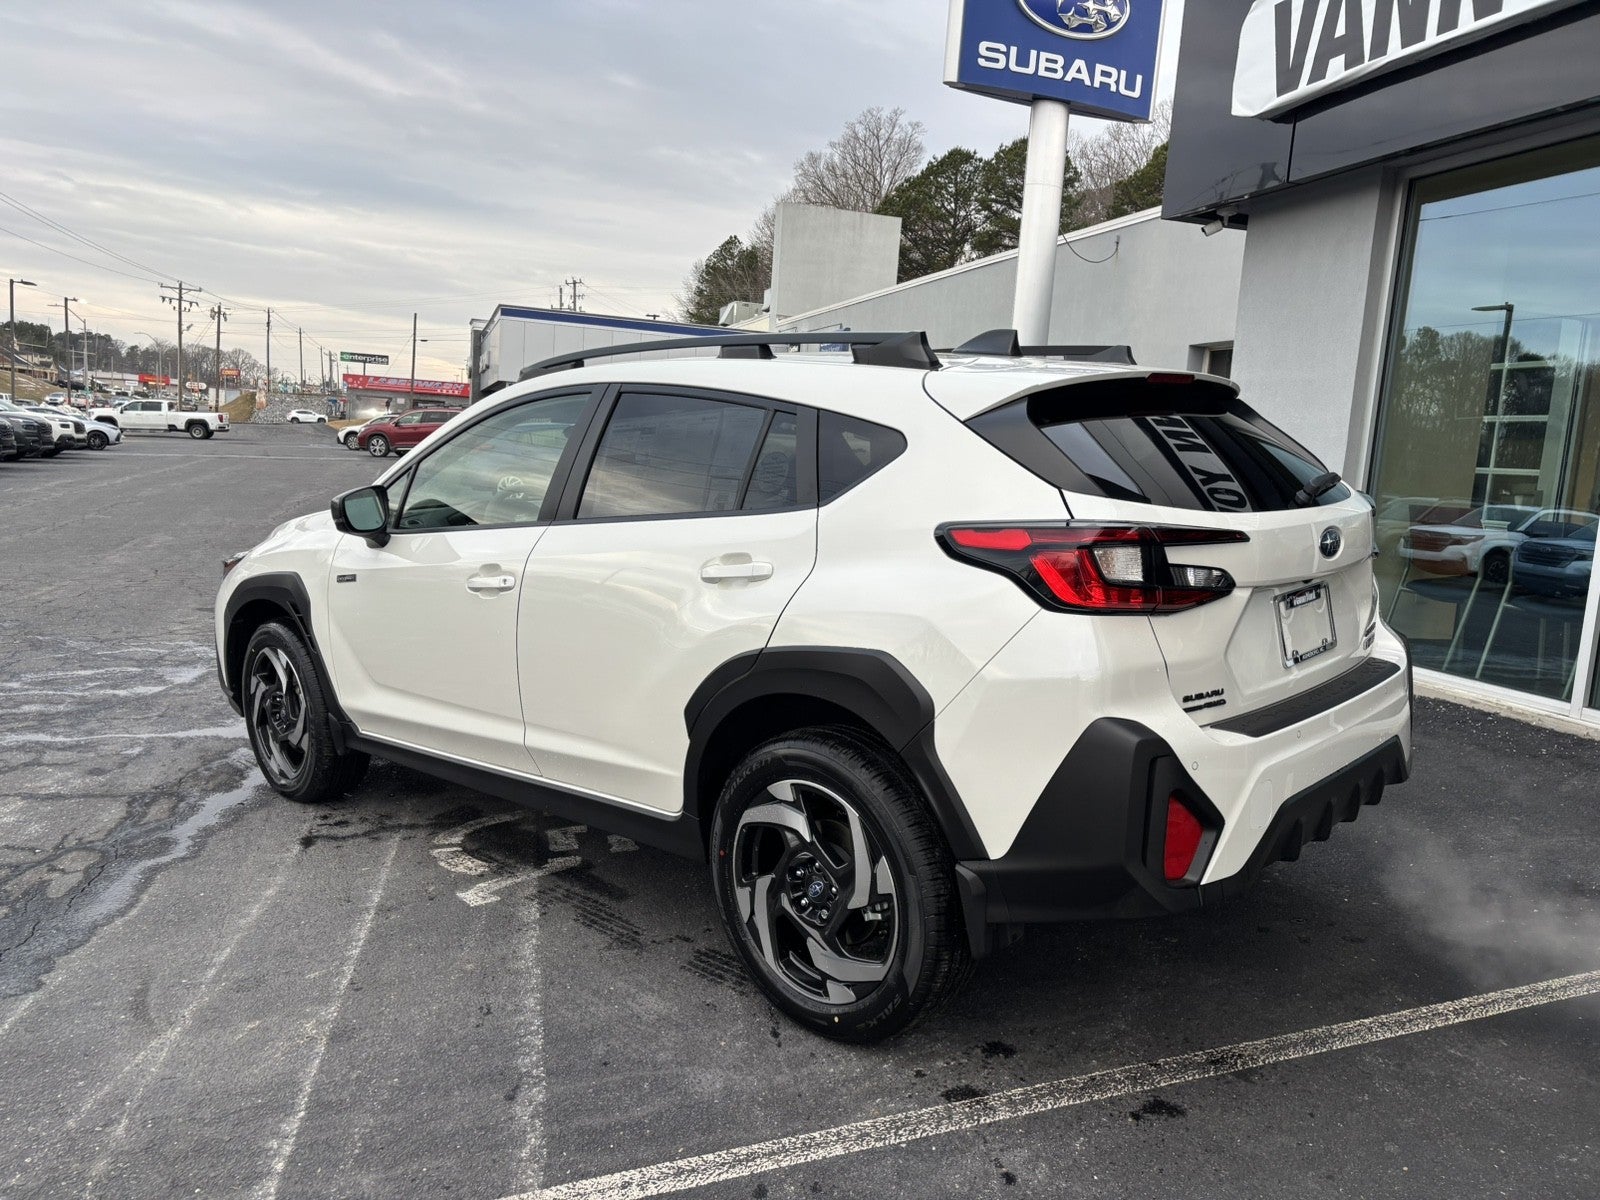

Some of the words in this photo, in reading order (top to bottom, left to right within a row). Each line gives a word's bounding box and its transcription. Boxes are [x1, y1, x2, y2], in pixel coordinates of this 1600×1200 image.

[977, 40, 1143, 100] SUBARU
[343, 353, 388, 363] enterprise
[1182, 688, 1224, 703] SUBARU
